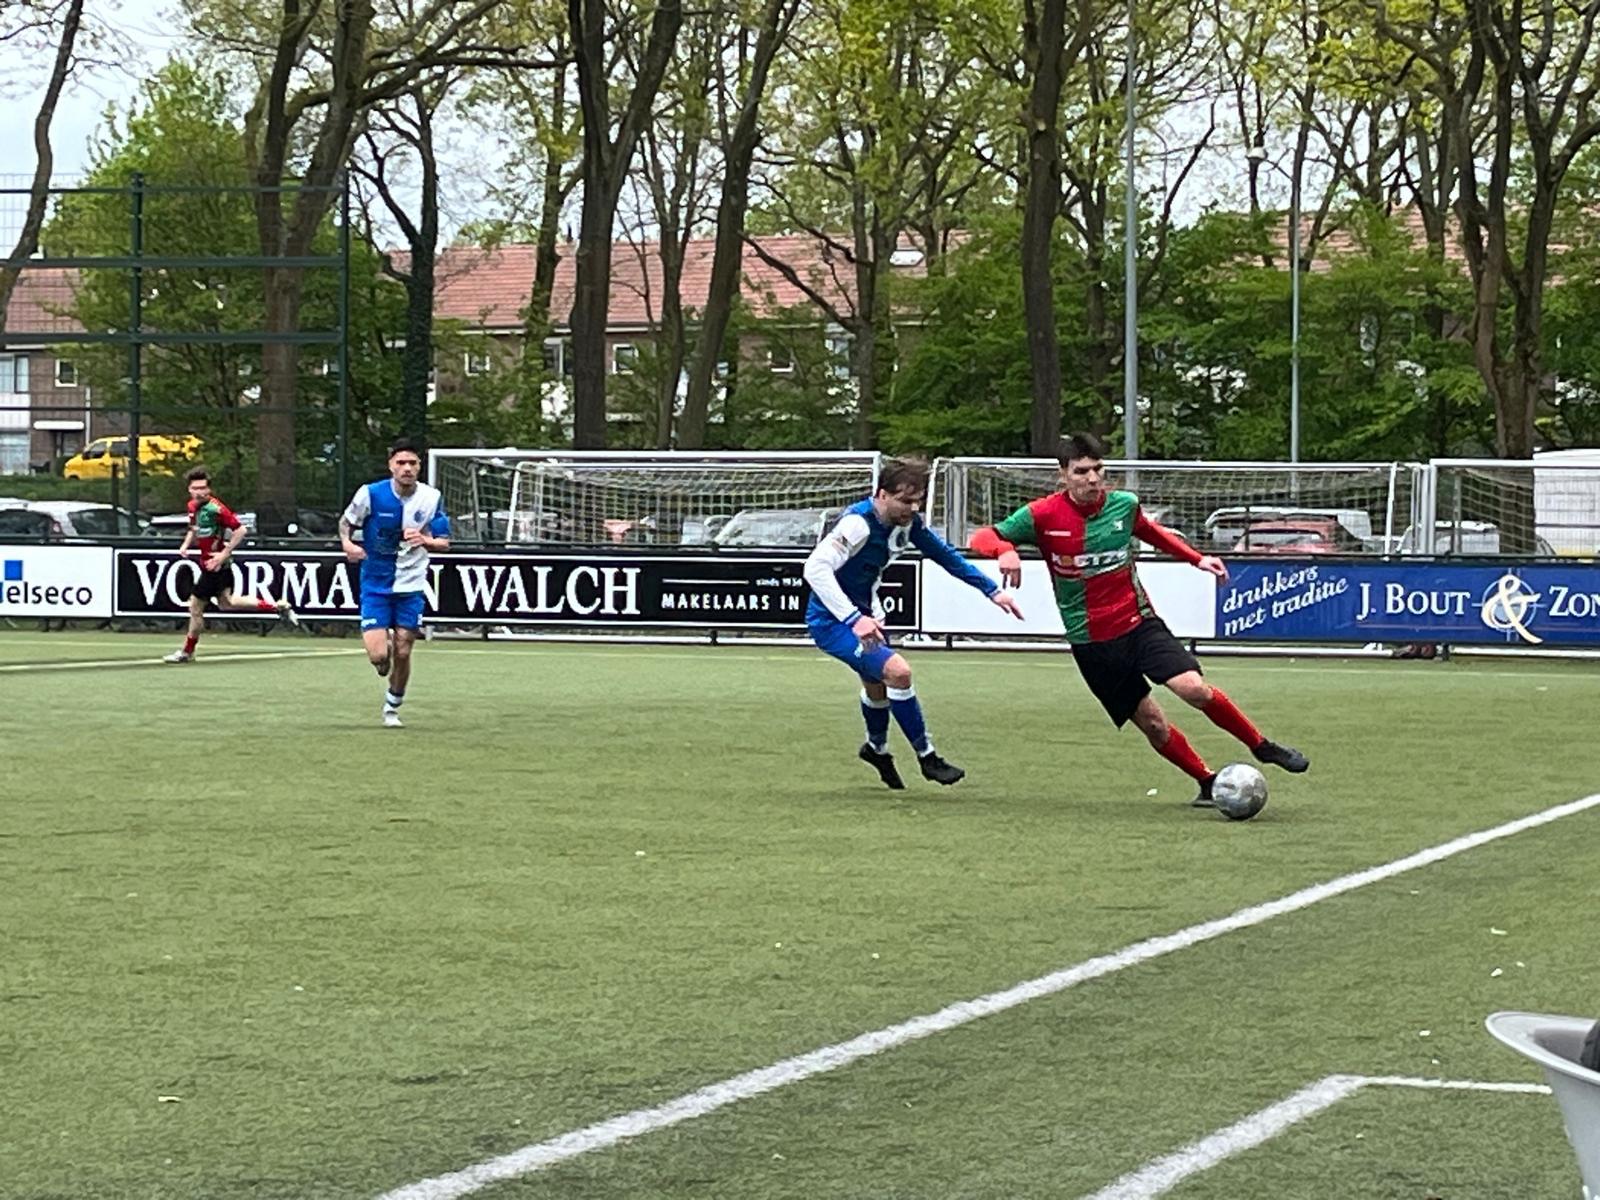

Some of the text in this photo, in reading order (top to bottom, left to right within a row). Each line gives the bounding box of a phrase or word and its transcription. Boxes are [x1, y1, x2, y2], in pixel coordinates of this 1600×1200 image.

[455, 564, 641, 614] WALCH
[661, 593, 770, 610] MAKELAARS
[780, 595, 799, 610] IN
[1222, 565, 1318, 613] drukkers
[1225, 575, 1349, 636] met traditie
[1356, 582, 1377, 620] J.
[1386, 583, 1471, 615] BOUT
[1481, 574, 1543, 643] &
